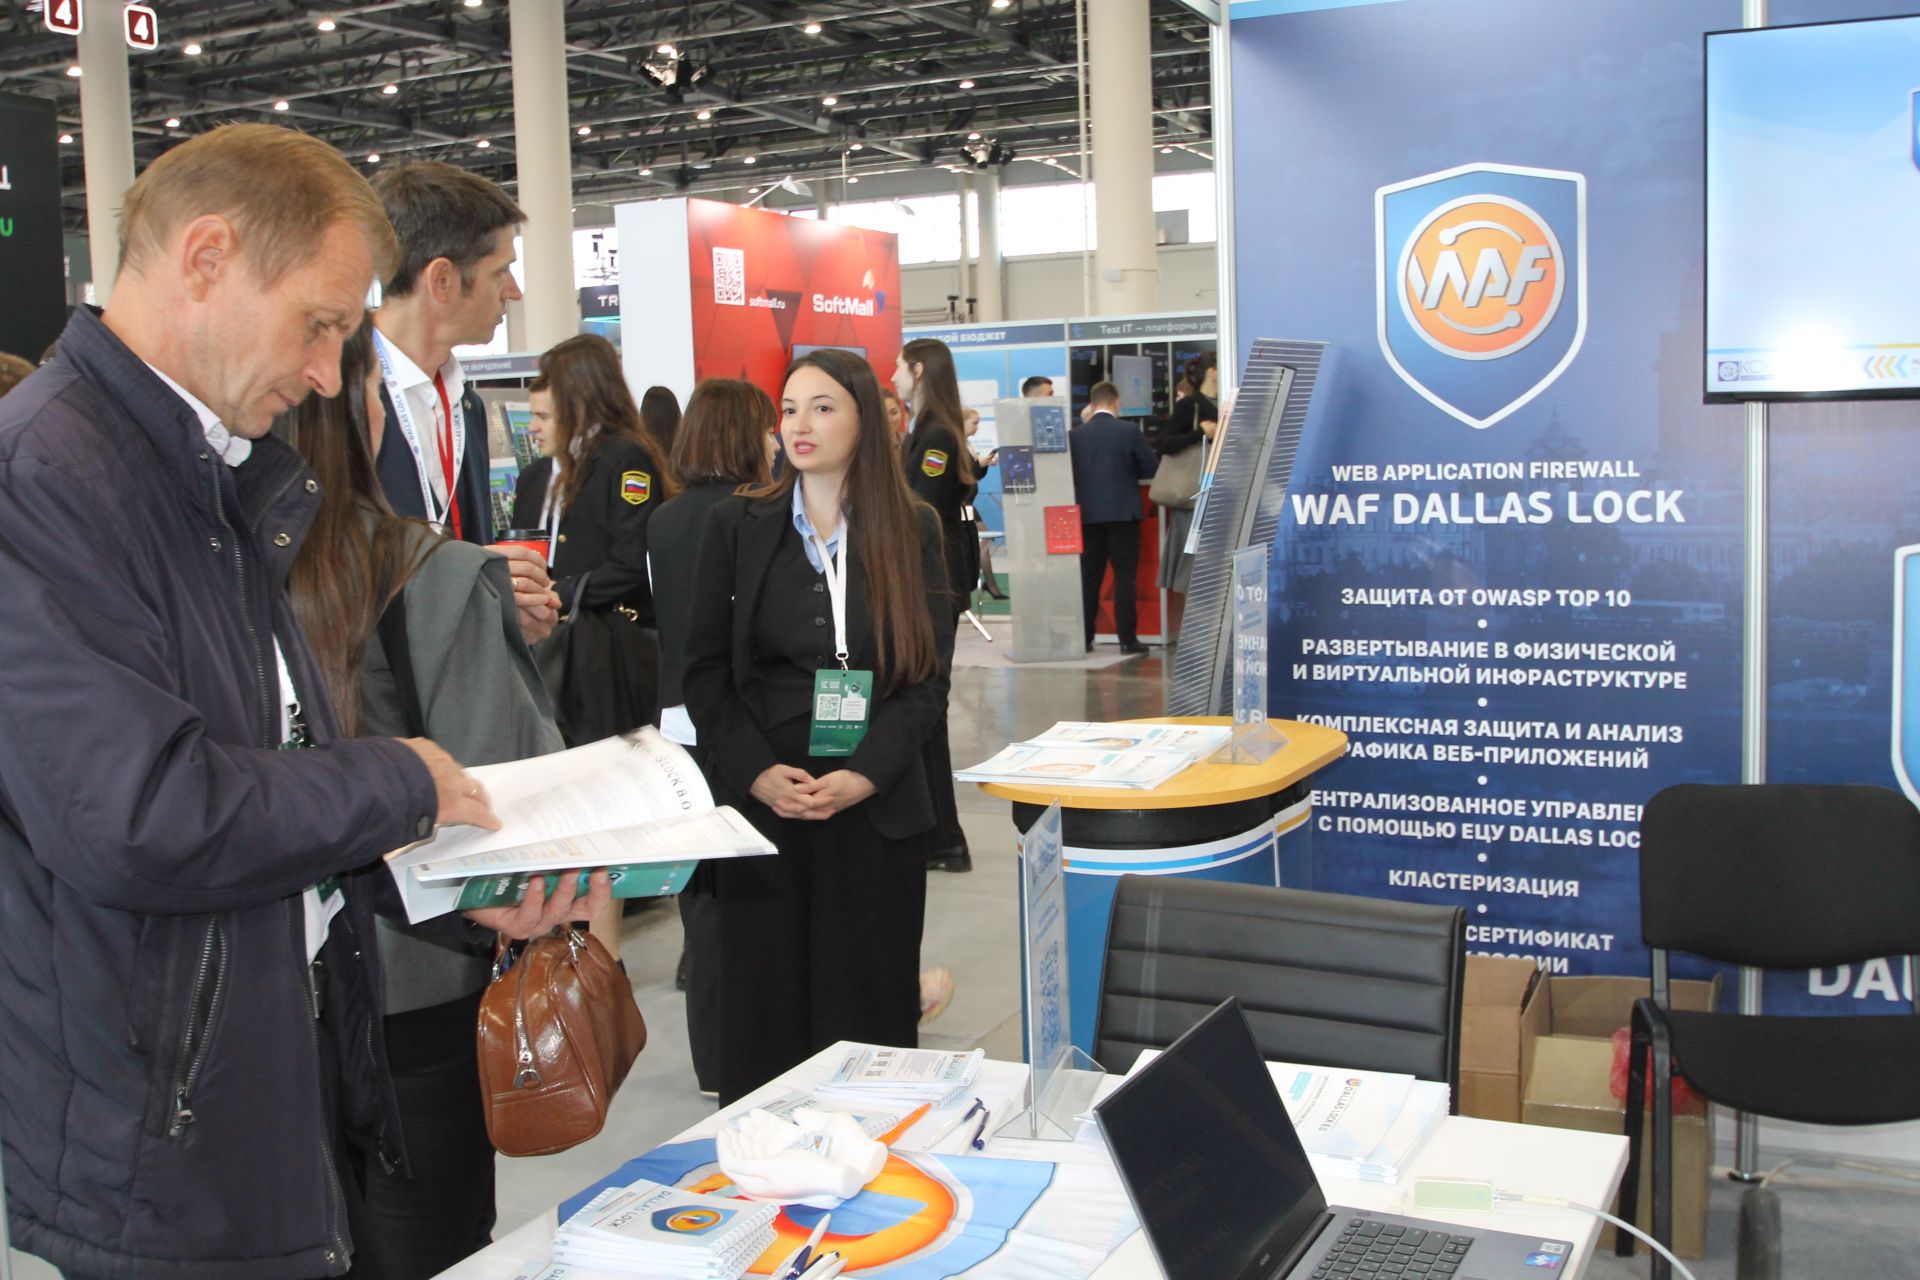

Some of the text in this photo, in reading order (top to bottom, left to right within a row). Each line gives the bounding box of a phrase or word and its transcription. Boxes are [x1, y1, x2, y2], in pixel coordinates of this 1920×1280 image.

[55, 0, 72, 25] 4
[133, 14, 149, 41] 4
[1408, 244, 1553, 310] WAF
[749, 295, 786, 310] softmall.ru
[812, 293, 874, 317] SoftMall
[960, 331, 1007, 343] БЮДЖЕТ
[1100, 324, 1121, 335] Test
[1122, 323, 1133, 334] IT
[1145, 320, 1197, 335] платформа
[1332, 459, 1640, 482] WEB APPLICATION FIREWALL
[1292, 489, 1686, 525] WAF DALLAS LOCK
[1341, 587, 1631, 607] ЗАЩИТА ОТ OWASP TOP 10
[1302, 638, 1676, 662] РАЗВЕРТЫВАНИЕ В ФИЗИЧЕСКОЙ
[1293, 663, 1306, 680] И
[1312, 662, 1470, 684] ВИРТУАЛЬНОЙ
[1476, 667, 1687, 689] ИНФРАСТРУКТУРЕ
[1296, 714, 1683, 743] КОМПЛЕКСНАЯ ЗАЩИТА И АНАЛИЗ
[1345, 741, 1649, 769] АФИКА ВЕБ-ПРИЛОЖЕНИЙ
[1310, 789, 1643, 822] ЕНТРАЛИЗОВАННОЕ УПРАВЛЕ
[1318, 815, 1641, 849] С ПОМОЩЬЮ ЕЦУ DALLAS LOC
[1389, 869, 1578, 898] КЛАСТЕРИЗАЦИЯ
[1465, 925, 1613, 951] СЕРТИФИКАТ
[1333, 1086, 1354, 1110] DALLAS
[1325, 1109, 1342, 1123] LOCK
[634, 1190, 672, 1213] DALLAS
[607, 1210, 639, 1229] LOCK
